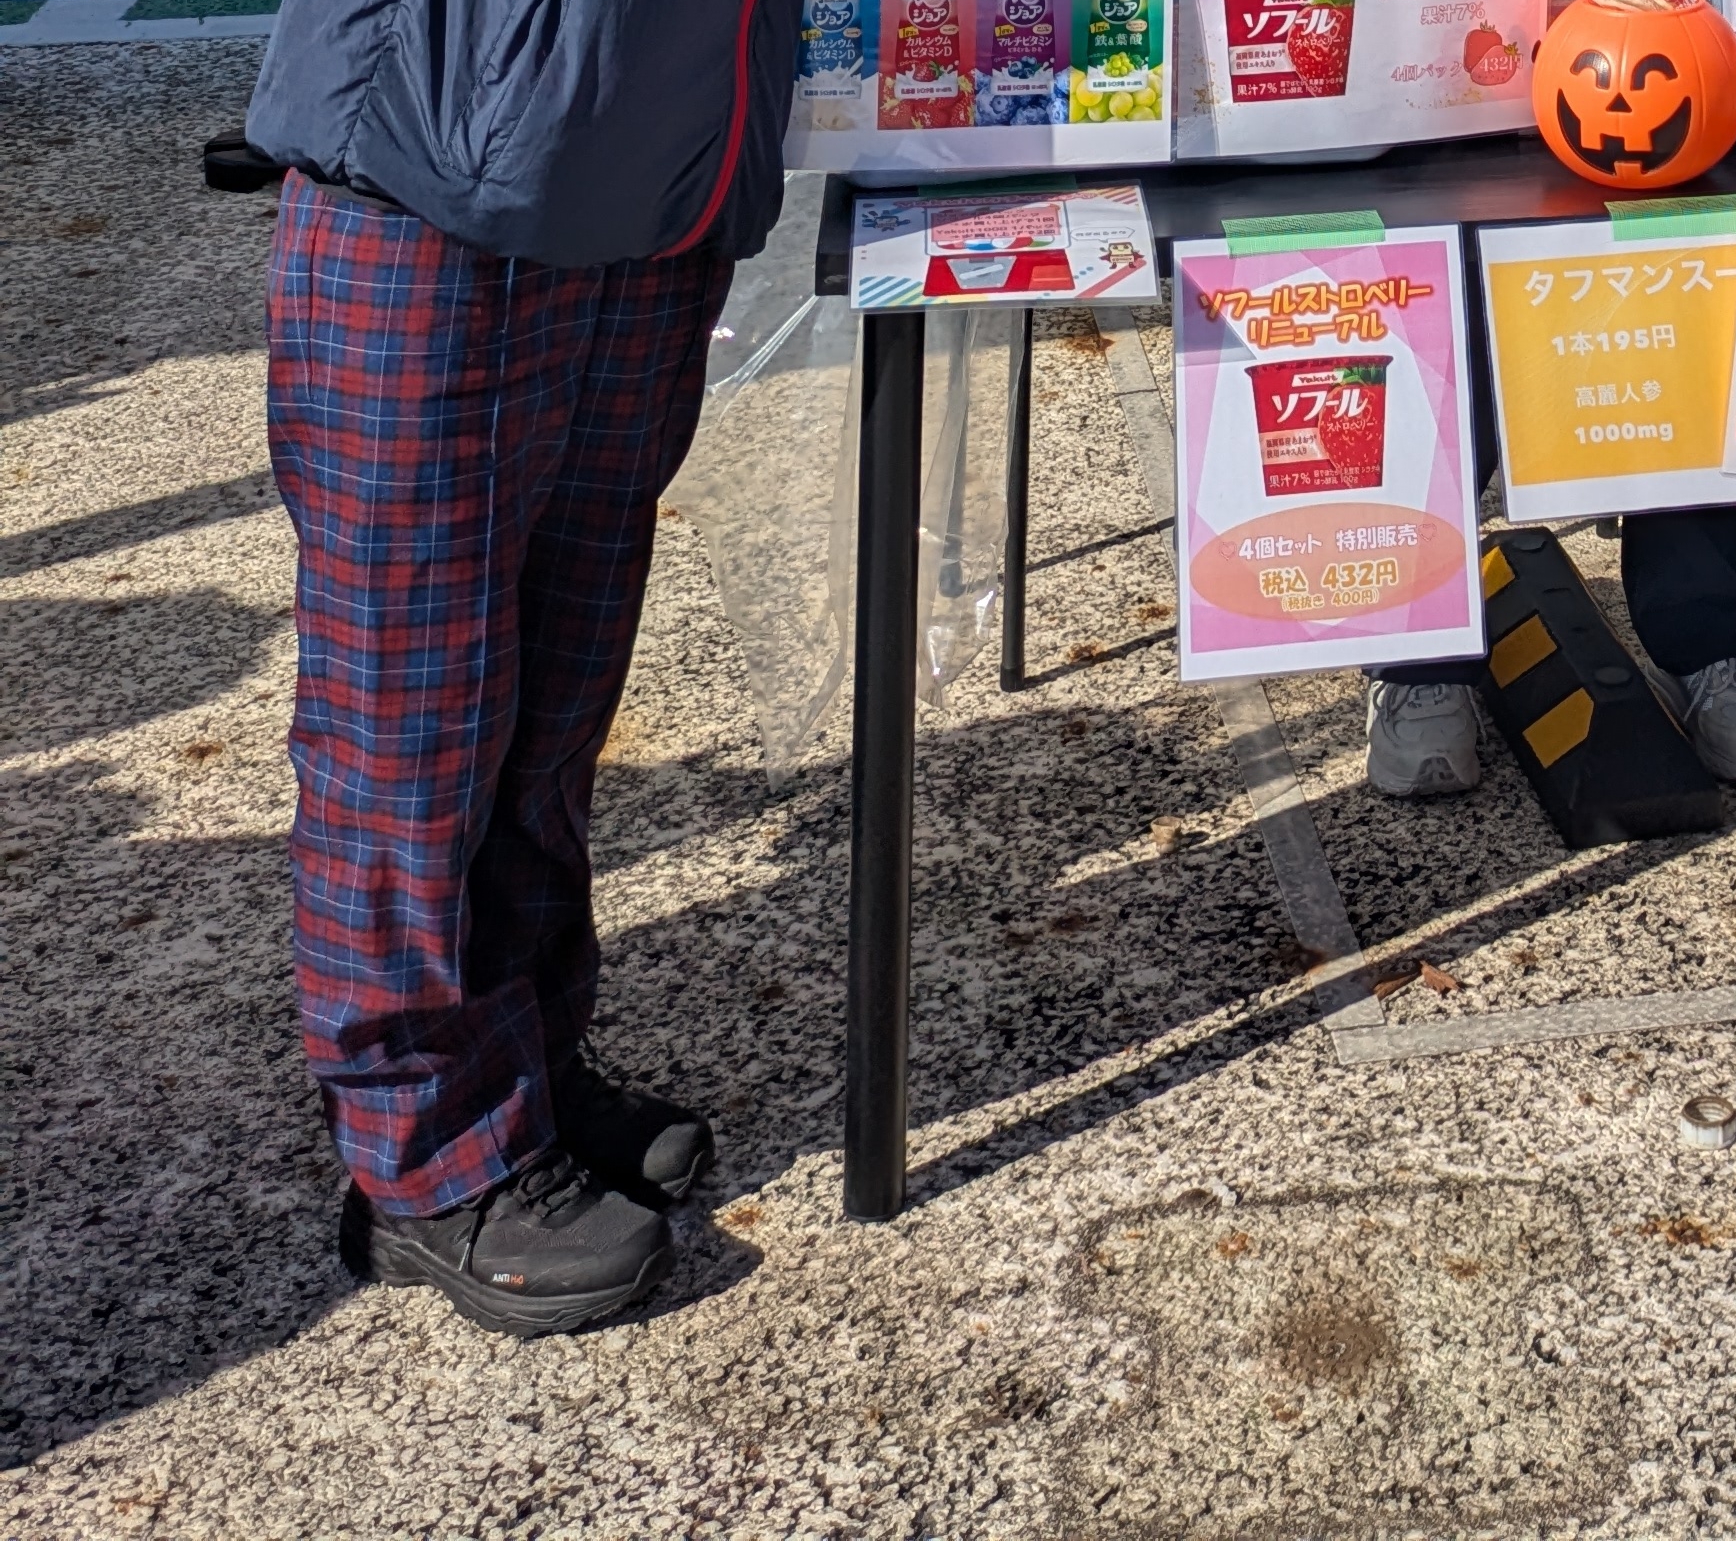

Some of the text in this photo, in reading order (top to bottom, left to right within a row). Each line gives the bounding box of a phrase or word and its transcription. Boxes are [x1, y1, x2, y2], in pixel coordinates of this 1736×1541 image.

[815, 10, 851, 26] ジョア
[912, 7, 948, 23] ジョア
[1009, 3, 1042, 20] ジョア
[1104, 1, 1138, 19] ジョア
[1420, 0, 1487, 26] 果汁7%
[1242, 8, 1337, 39] ソフール
[1480, 53, 1525, 72] 432円
[1237, 82, 1278, 97] 果汁7%
[1199, 277, 1433, 321] ソフールストロベリー
[1249, 311, 1388, 348] リニューアル
[1550, 323, 1677, 357] 1本195円
[1299, 375, 1338, 385] Yakult
[1574, 379, 1663, 409] 高麗人参
[1271, 388, 1369, 424] ソフール
[1326, 418, 1375, 432] ストロベリー
[1573, 422, 1674, 445] 1000mg
[1269, 471, 1312, 488] 果汁7%
[1238, 523, 1419, 560] 4個セット 特別販売
[1260, 557, 1399, 597] 税込 432円
